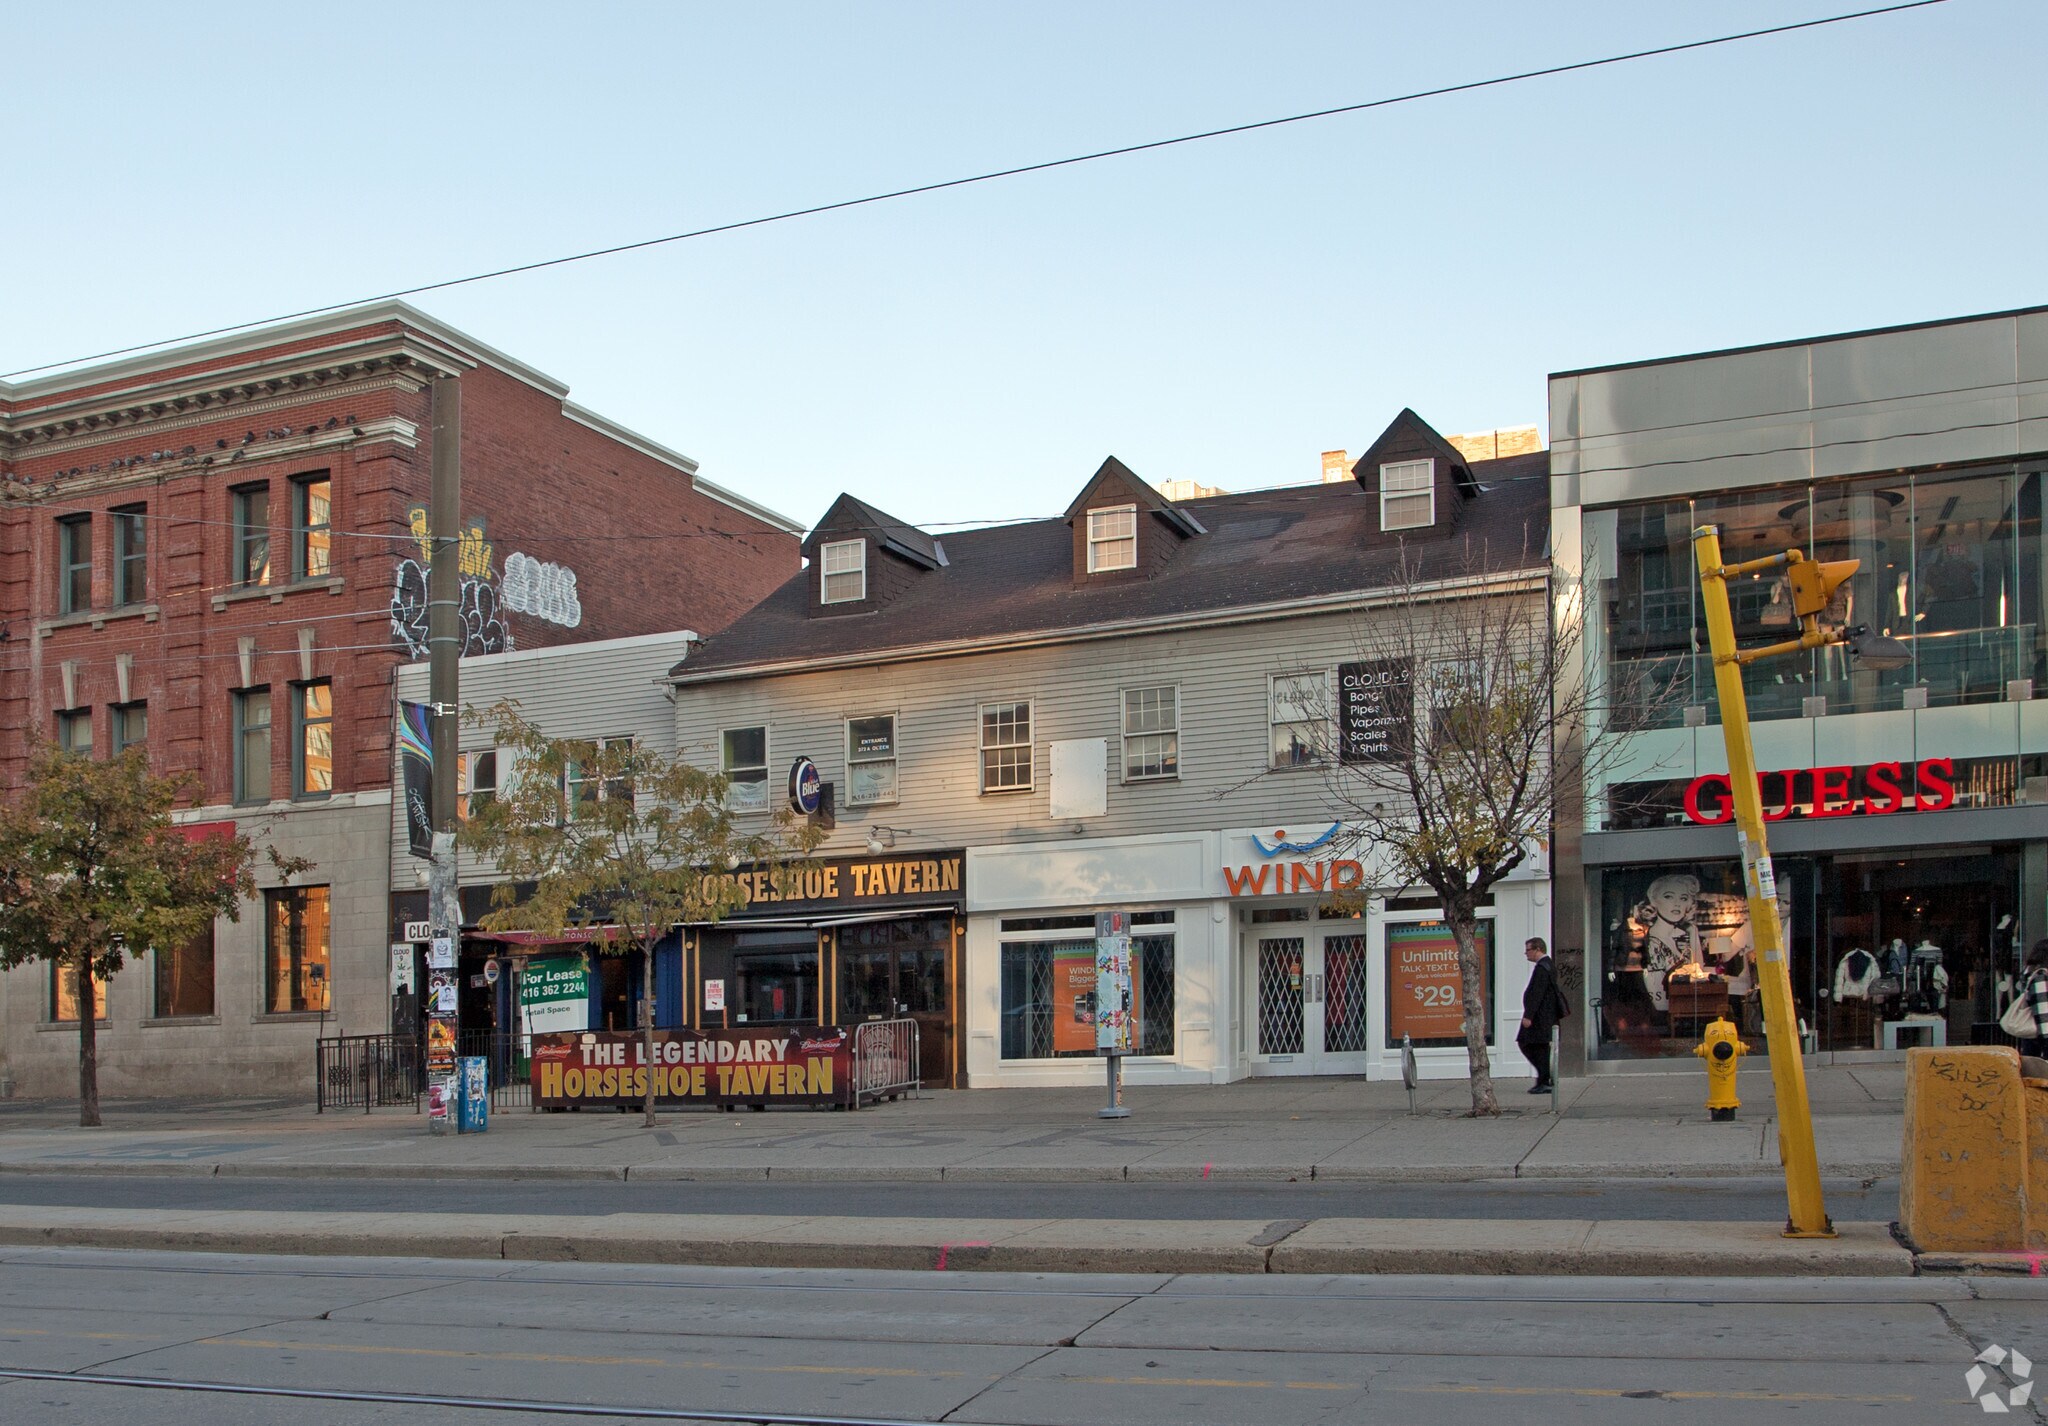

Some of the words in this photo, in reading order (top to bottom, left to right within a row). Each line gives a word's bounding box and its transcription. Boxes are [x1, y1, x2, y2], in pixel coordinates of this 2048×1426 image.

[1350, 705, 1380, 716] Pipes
[861, 737, 887, 745] ENTRANCE
[1350, 731, 1387, 742] Scales
[802, 782, 820, 797] Blue
[1683, 757, 1954, 825] GUESS
[685, 867, 839, 905] ORSESHOE
[851, 858, 961, 896] TAVERN
[1222, 860, 1364, 896] WIND
[409, 924, 430, 939] CLO
[1402, 949, 1459, 963] Unlimite
[1069, 967, 1096, 975] WIND
[1400, 965, 1422, 973] TALK
[1426, 963, 1448, 972] TEXT
[1453, 963, 1459, 971] D
[522, 972, 543, 985] For
[546, 970, 583, 982] Lease
[522, 986, 540, 998] 416
[542, 984, 560, 996] 362
[563, 982, 585, 994] 2244
[525, 1008, 545, 1016] Retail
[547, 1006, 571, 1014] Space
[800, 1038, 842, 1050] Budweiser
[580, 1042, 632, 1066] THE
[636, 1039, 790, 1065] LEGENDARY
[540, 1062, 706, 1098] HORSESHOE
[716, 1056, 834, 1095] TAVERN
